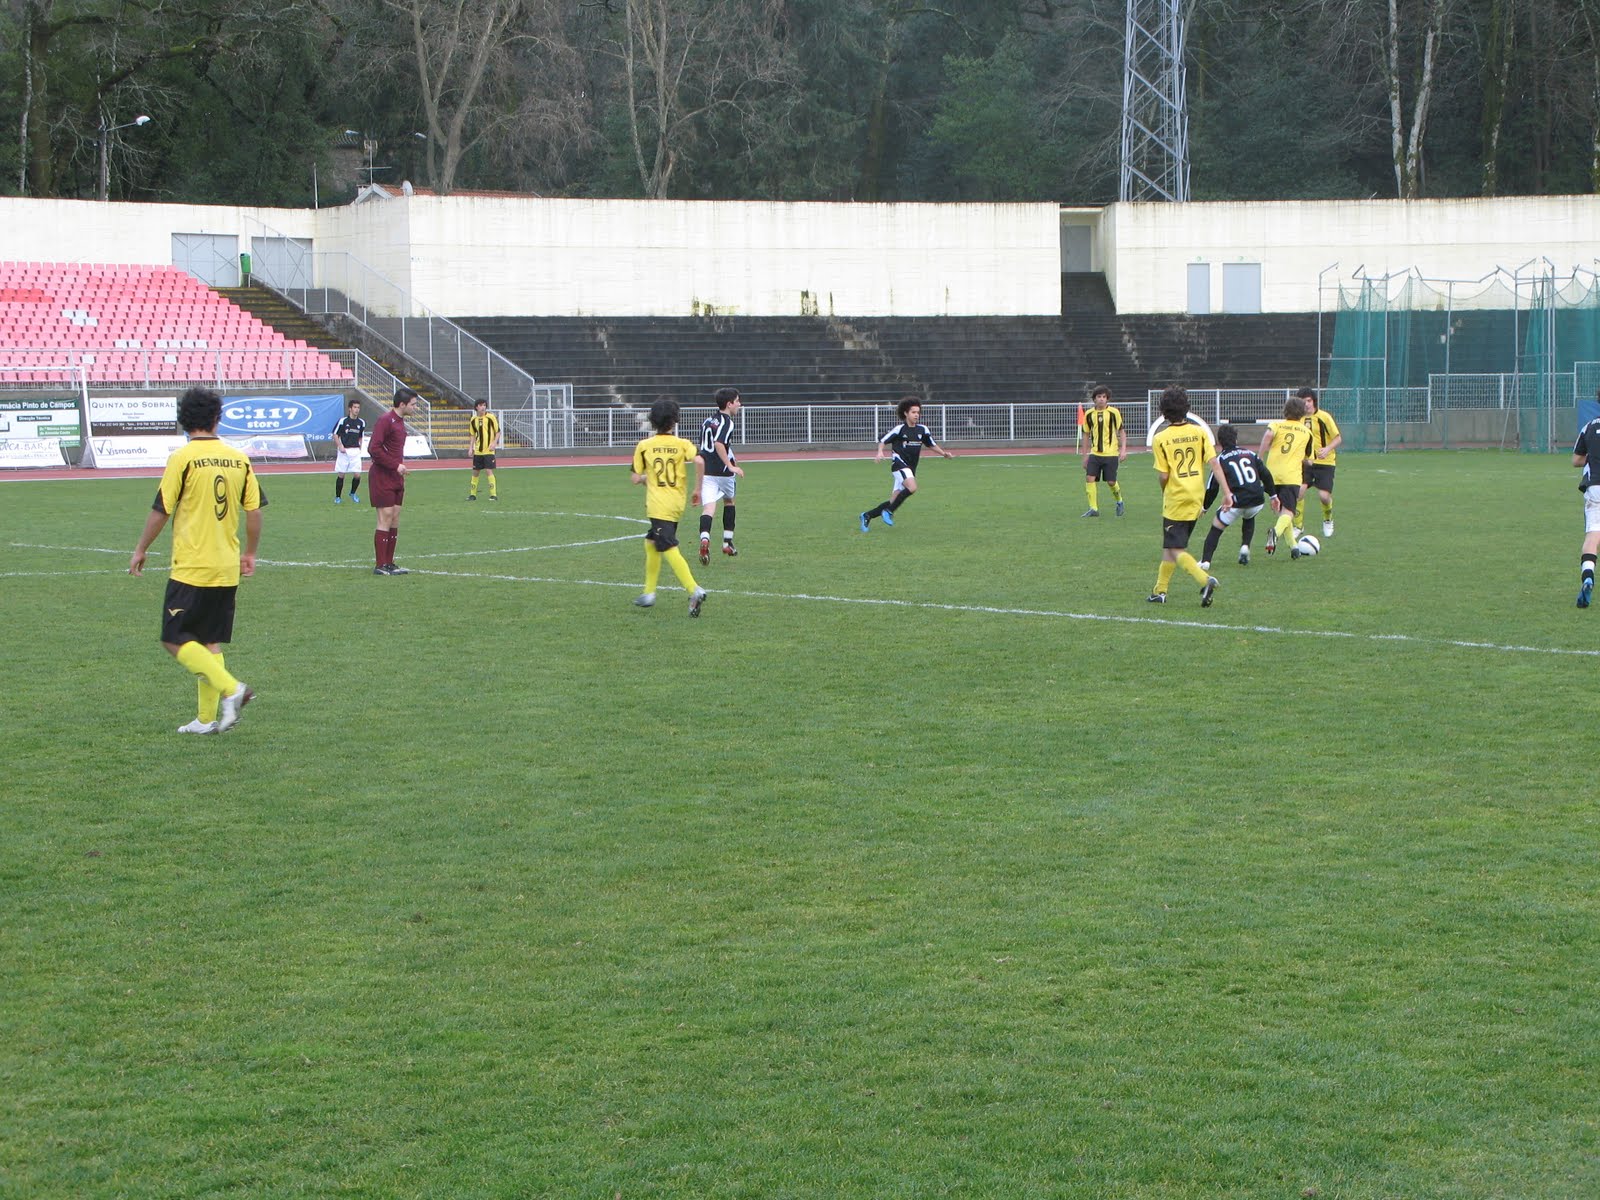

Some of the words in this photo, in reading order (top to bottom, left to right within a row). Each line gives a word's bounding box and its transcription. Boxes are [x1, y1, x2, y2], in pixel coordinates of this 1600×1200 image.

[22, 401, 39, 409] Pinto
[49, 401, 75, 410] Campos
[247, 420, 280, 429] store
[1280, 432, 1295, 454] 3
[653, 457, 677, 488] 20
[1173, 447, 1200, 479] 22
[1228, 457, 1257, 486] 16
[214, 474, 229, 522] 9
